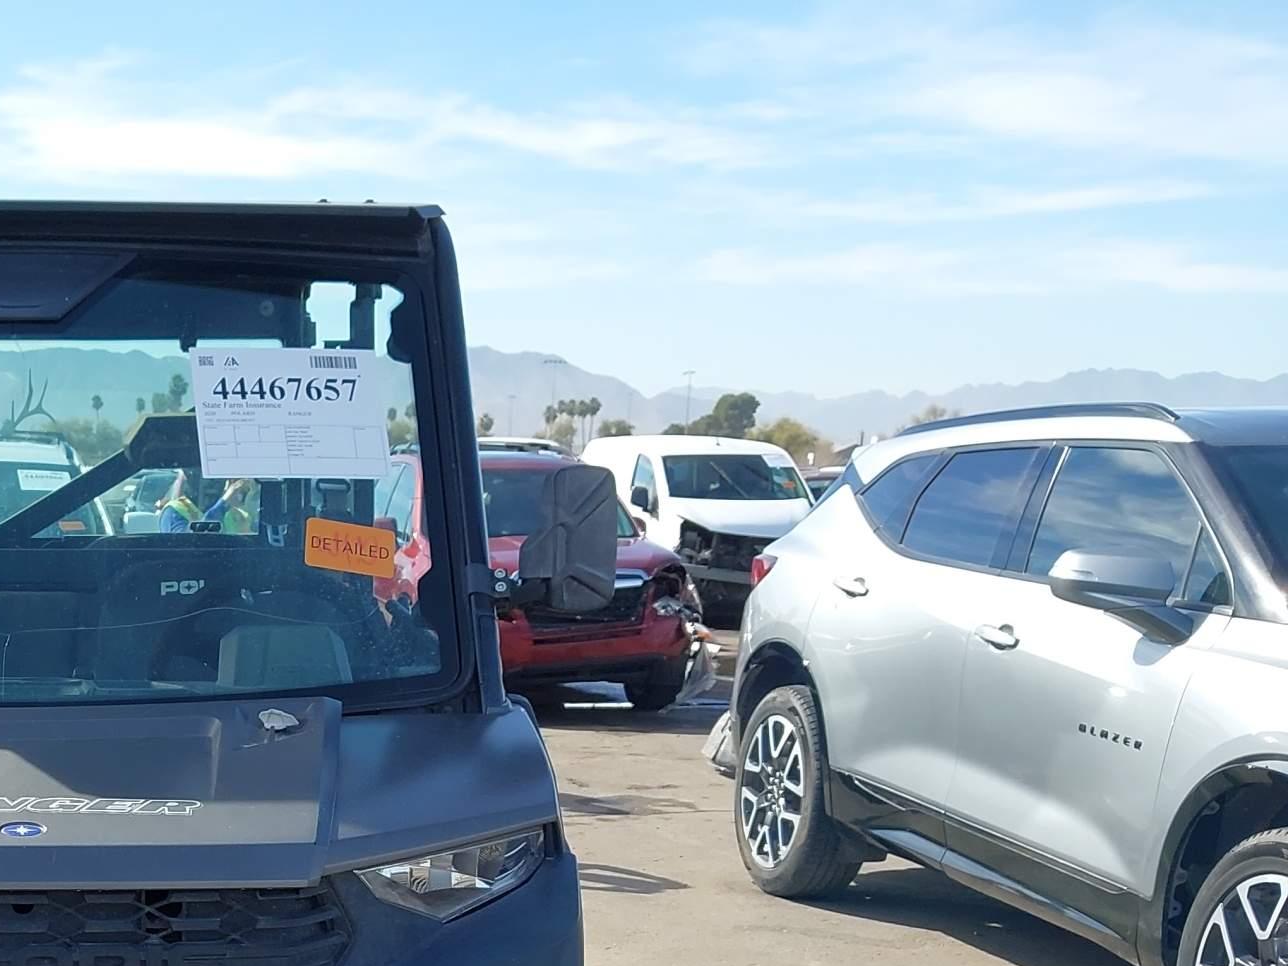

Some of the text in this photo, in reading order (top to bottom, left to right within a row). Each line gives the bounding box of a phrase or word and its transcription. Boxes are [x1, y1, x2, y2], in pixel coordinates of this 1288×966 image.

[212, 376, 358, 402] 44467657
[202, 401, 222, 409] State
[311, 535, 390, 560] DETAILED
[1078, 723, 1143, 751] BLAZER
